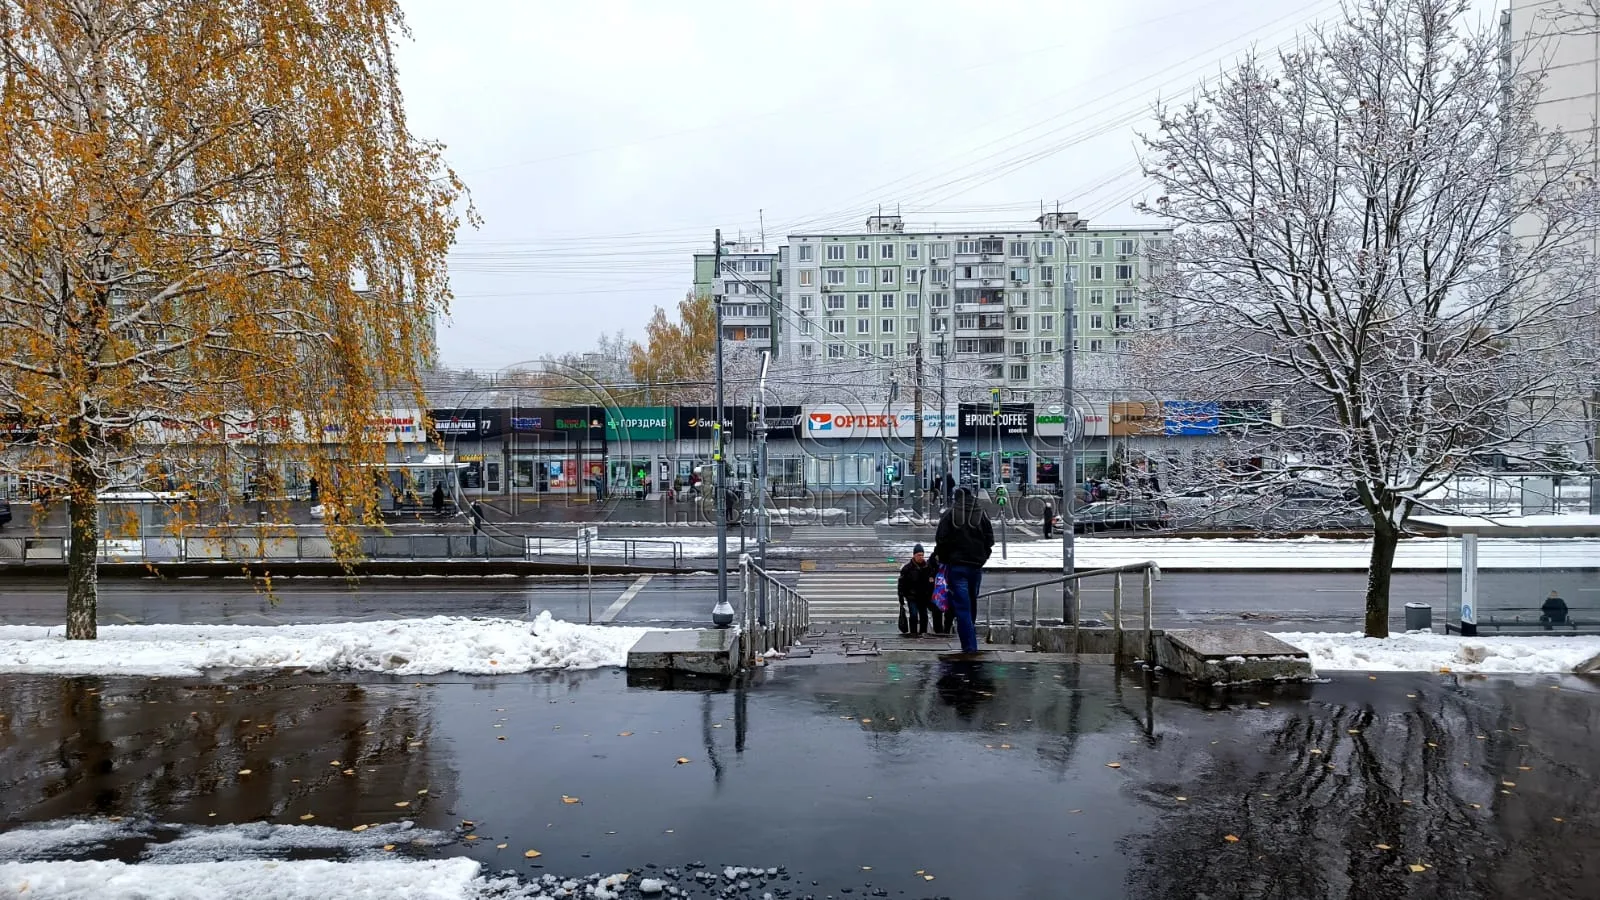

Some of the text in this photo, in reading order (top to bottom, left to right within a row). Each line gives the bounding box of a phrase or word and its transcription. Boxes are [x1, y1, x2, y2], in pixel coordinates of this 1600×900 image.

[620, 418, 667, 429] ГОРЗДРАВ
[699, 417, 733, 428] билйн
[971, 414, 996, 426] PRICE
[997, 414, 1028, 426] COFFEE
